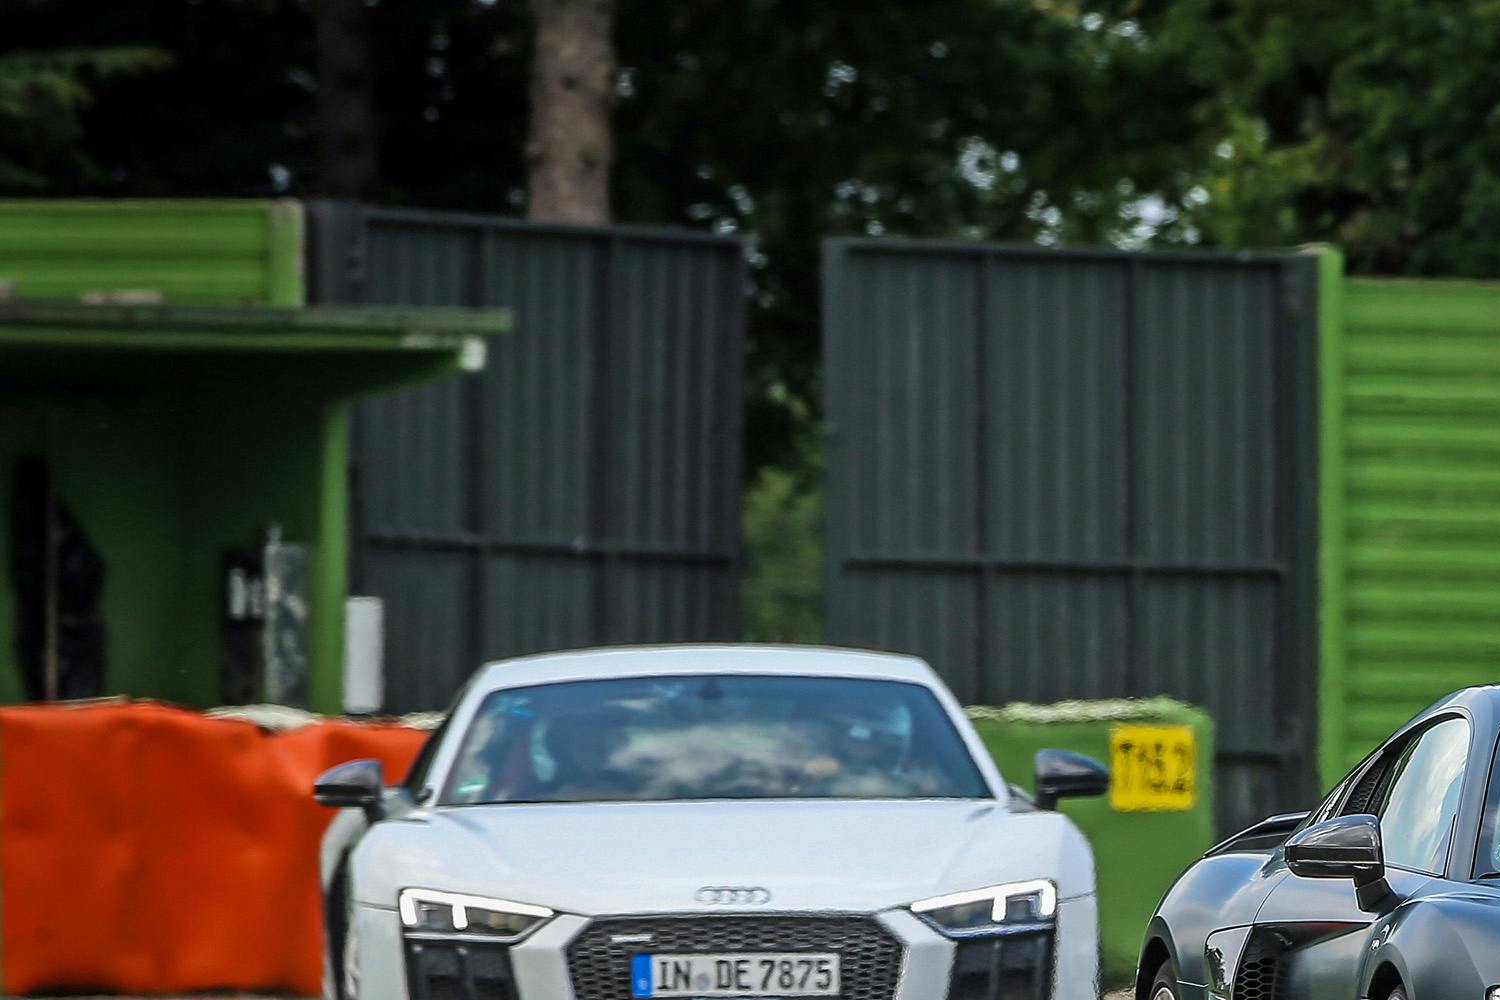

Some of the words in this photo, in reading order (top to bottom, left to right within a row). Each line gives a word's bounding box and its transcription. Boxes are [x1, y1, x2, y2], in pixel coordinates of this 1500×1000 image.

[656, 960, 690, 990] IN
[716, 959, 751, 989] DE
[759, 959, 832, 989] 7875
